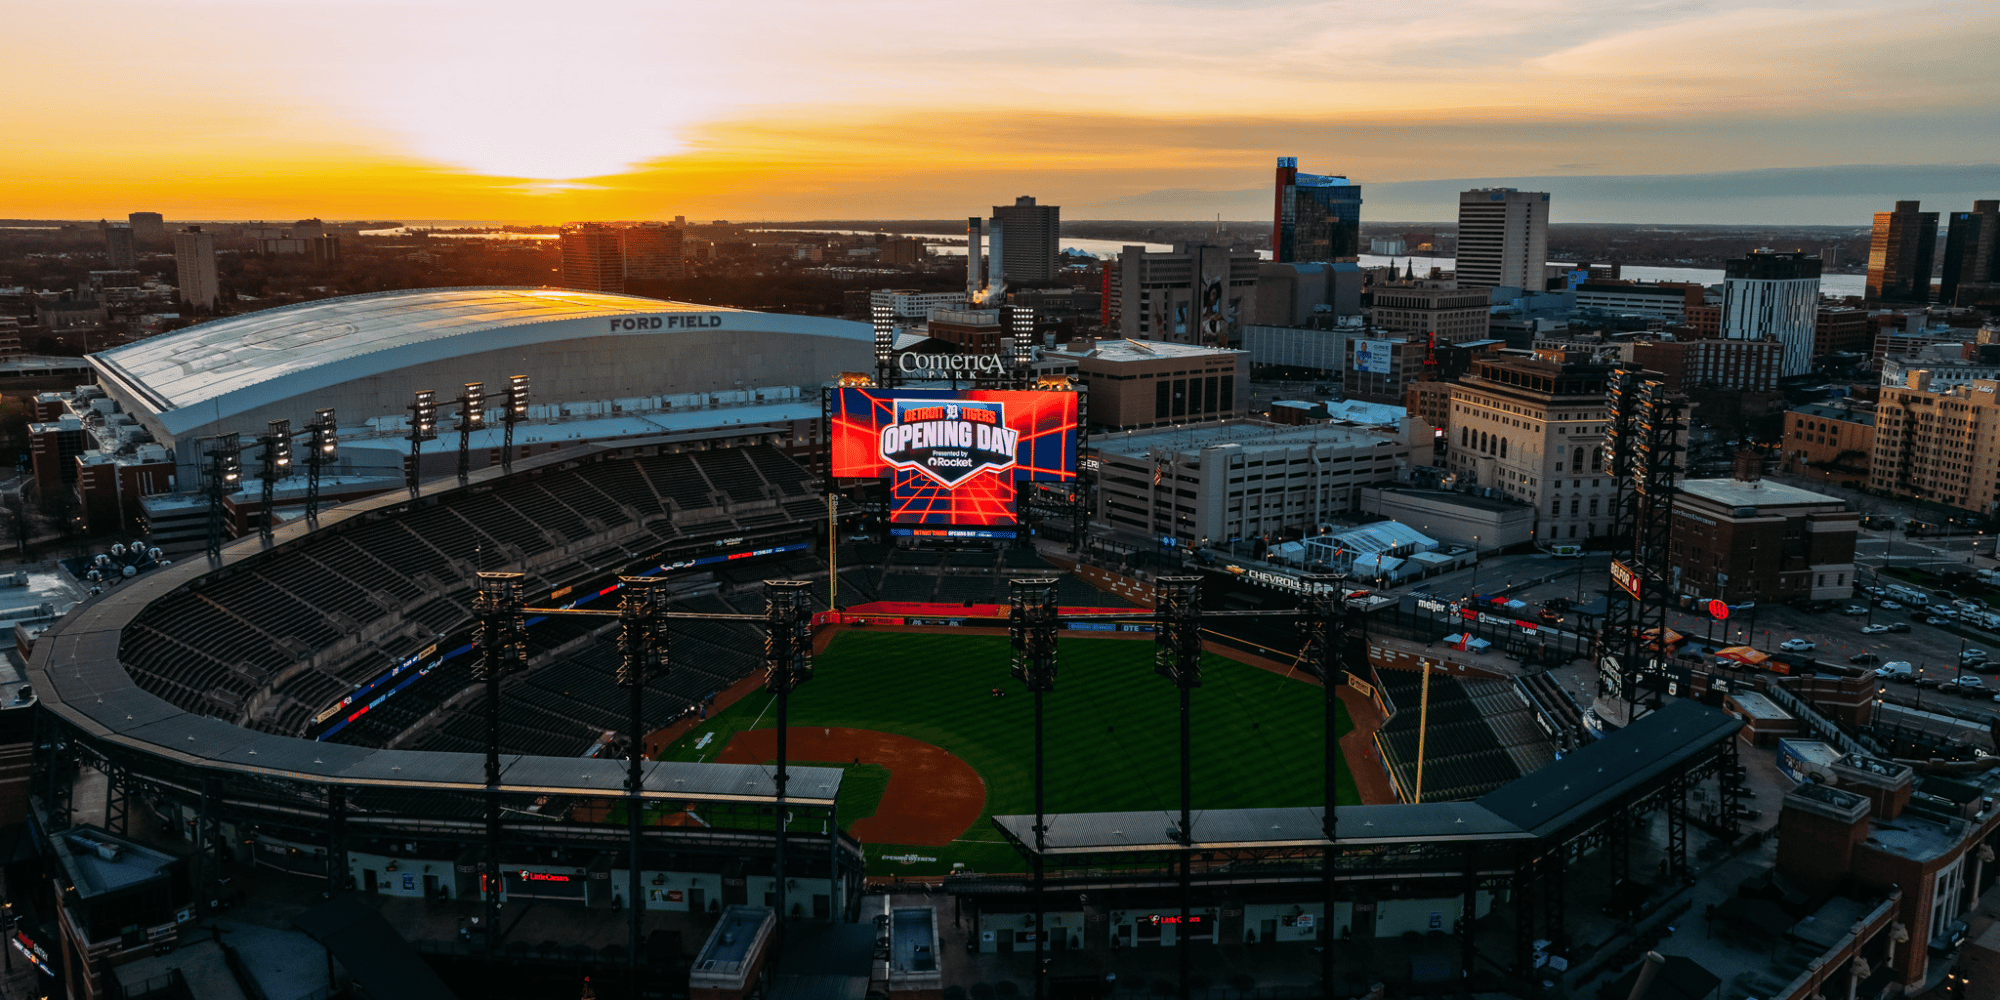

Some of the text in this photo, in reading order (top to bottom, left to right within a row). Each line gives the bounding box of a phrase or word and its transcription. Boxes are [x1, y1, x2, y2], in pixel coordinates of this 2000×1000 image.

[610, 311, 722, 337] FORD FIELD
[928, 371, 977, 379] PARK
[903, 407, 944, 423] DETROIT
[961, 407, 996, 424] TIGERS
[884, 421, 1018, 457] OPENING DAY
[937, 457, 972, 468] Rocket
[959, 451, 968, 459] by
[1249, 570, 1310, 590] CHEVROLET
[1610, 561, 1631, 586] BELFOR
[1418, 599, 1446, 612] meijer
[1522, 627, 1537, 636] LAW
